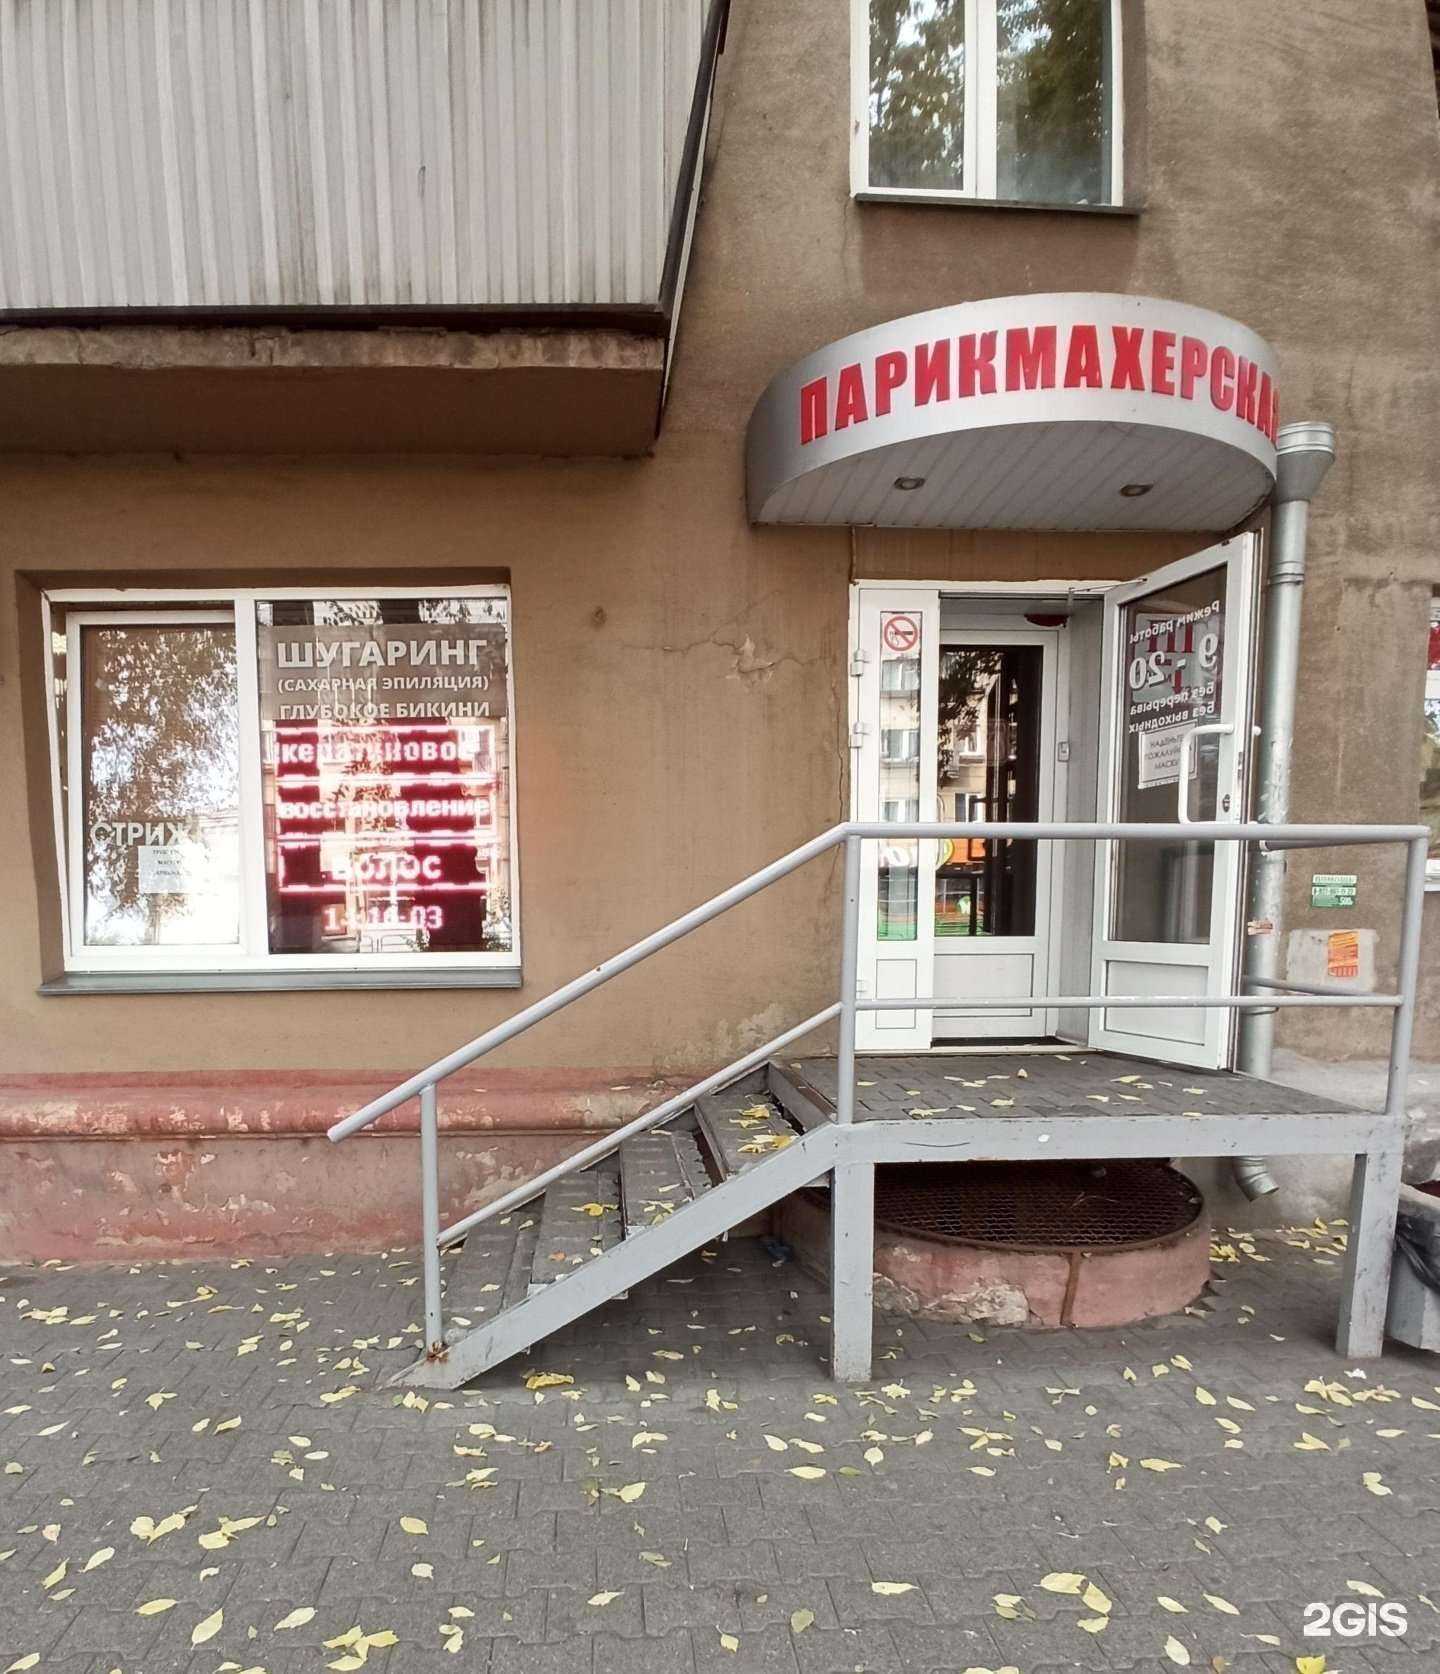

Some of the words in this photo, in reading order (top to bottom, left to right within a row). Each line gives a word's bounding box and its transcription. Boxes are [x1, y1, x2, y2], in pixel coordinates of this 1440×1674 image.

[277, 639, 488, 668] ШУГАРИНГ
[382, 675, 489, 692] ЭПИЛЯЦИЯ)
[280, 703, 390, 719] ГЛУБОКОЕ
[396, 702, 490, 718] БИКИНИ
